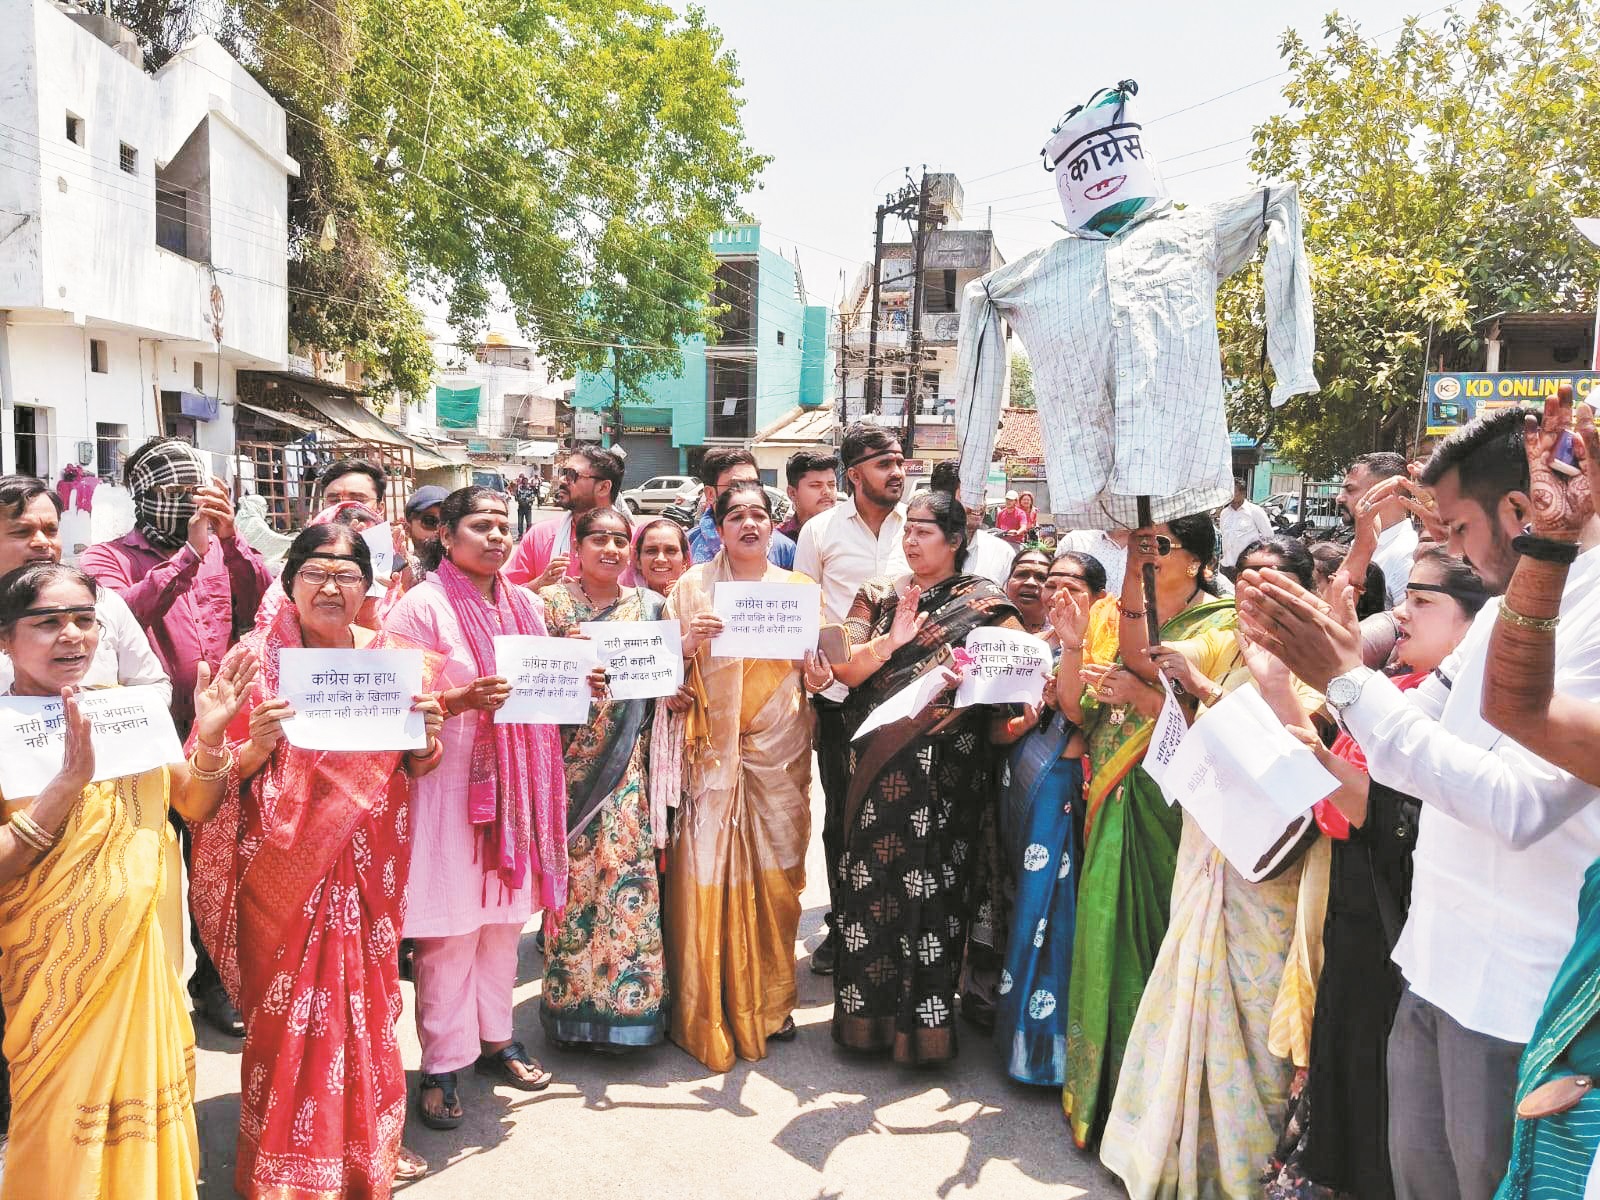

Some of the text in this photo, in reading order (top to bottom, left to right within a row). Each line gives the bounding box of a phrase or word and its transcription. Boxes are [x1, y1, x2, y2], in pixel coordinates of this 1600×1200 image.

[1067, 131, 1144, 181] कांग्रेस
[1466, 379, 1494, 397] KD
[1576, 378, 1600, 397] C
[735, 597, 798, 610] कांग्रेस का हाथ
[731, 613, 746, 622] नारी
[747, 612, 766, 622] शक्ति
[768, 613, 775, 621] के
[767, 624, 786, 633] करेगी
[604, 637, 621, 649] नारी
[650, 635, 662, 646] की
[1009, 640, 1020, 652] के
[521, 655, 578, 671] कांग्रेस का हाथ
[630, 654, 656, 667] कहानी
[980, 654, 1008, 664] सवाल
[311, 669, 396, 686] कांग्रेस का हाथ
[620, 671, 629, 680] की
[652, 668, 672, 681] पुरानी
[970, 664, 1034, 678] की पुरानी चाल
[550, 673, 556, 684] के
[305, 690, 400, 703] नारी शक्ति के खिलाफ
[516, 688, 532, 696] जनता
[305, 709, 331, 719] जनता
[354, 705, 378, 717] करेगी
[14, 719, 41, 733] नारी
[103, 705, 145, 717] अपमान
[24, 732, 48, 748] नहीं
[94, 717, 149, 734] हिन्दुस्तान
